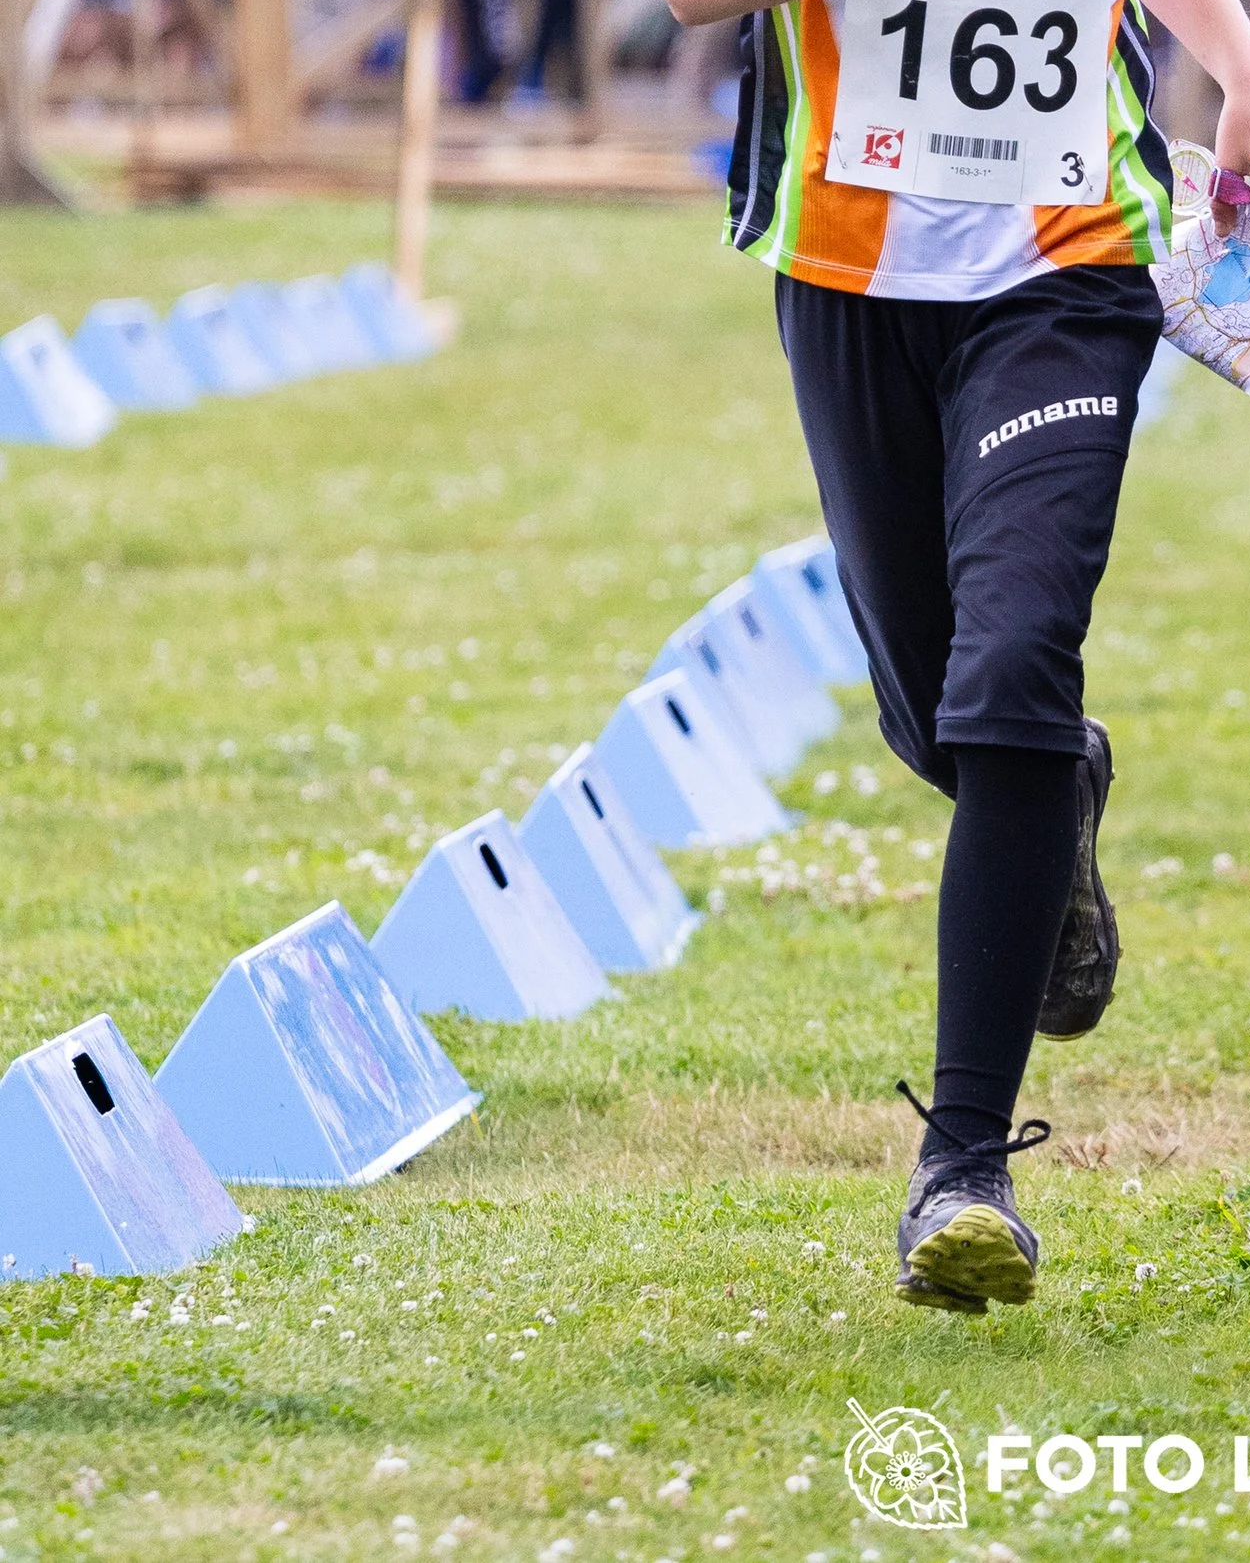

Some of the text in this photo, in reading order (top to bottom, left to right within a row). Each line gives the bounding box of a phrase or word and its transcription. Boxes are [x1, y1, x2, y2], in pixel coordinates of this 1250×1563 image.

[881, 0, 1078, 113] 163
[1060, 151, 1084, 188] 3
[978, 396, 1118, 458] noname
